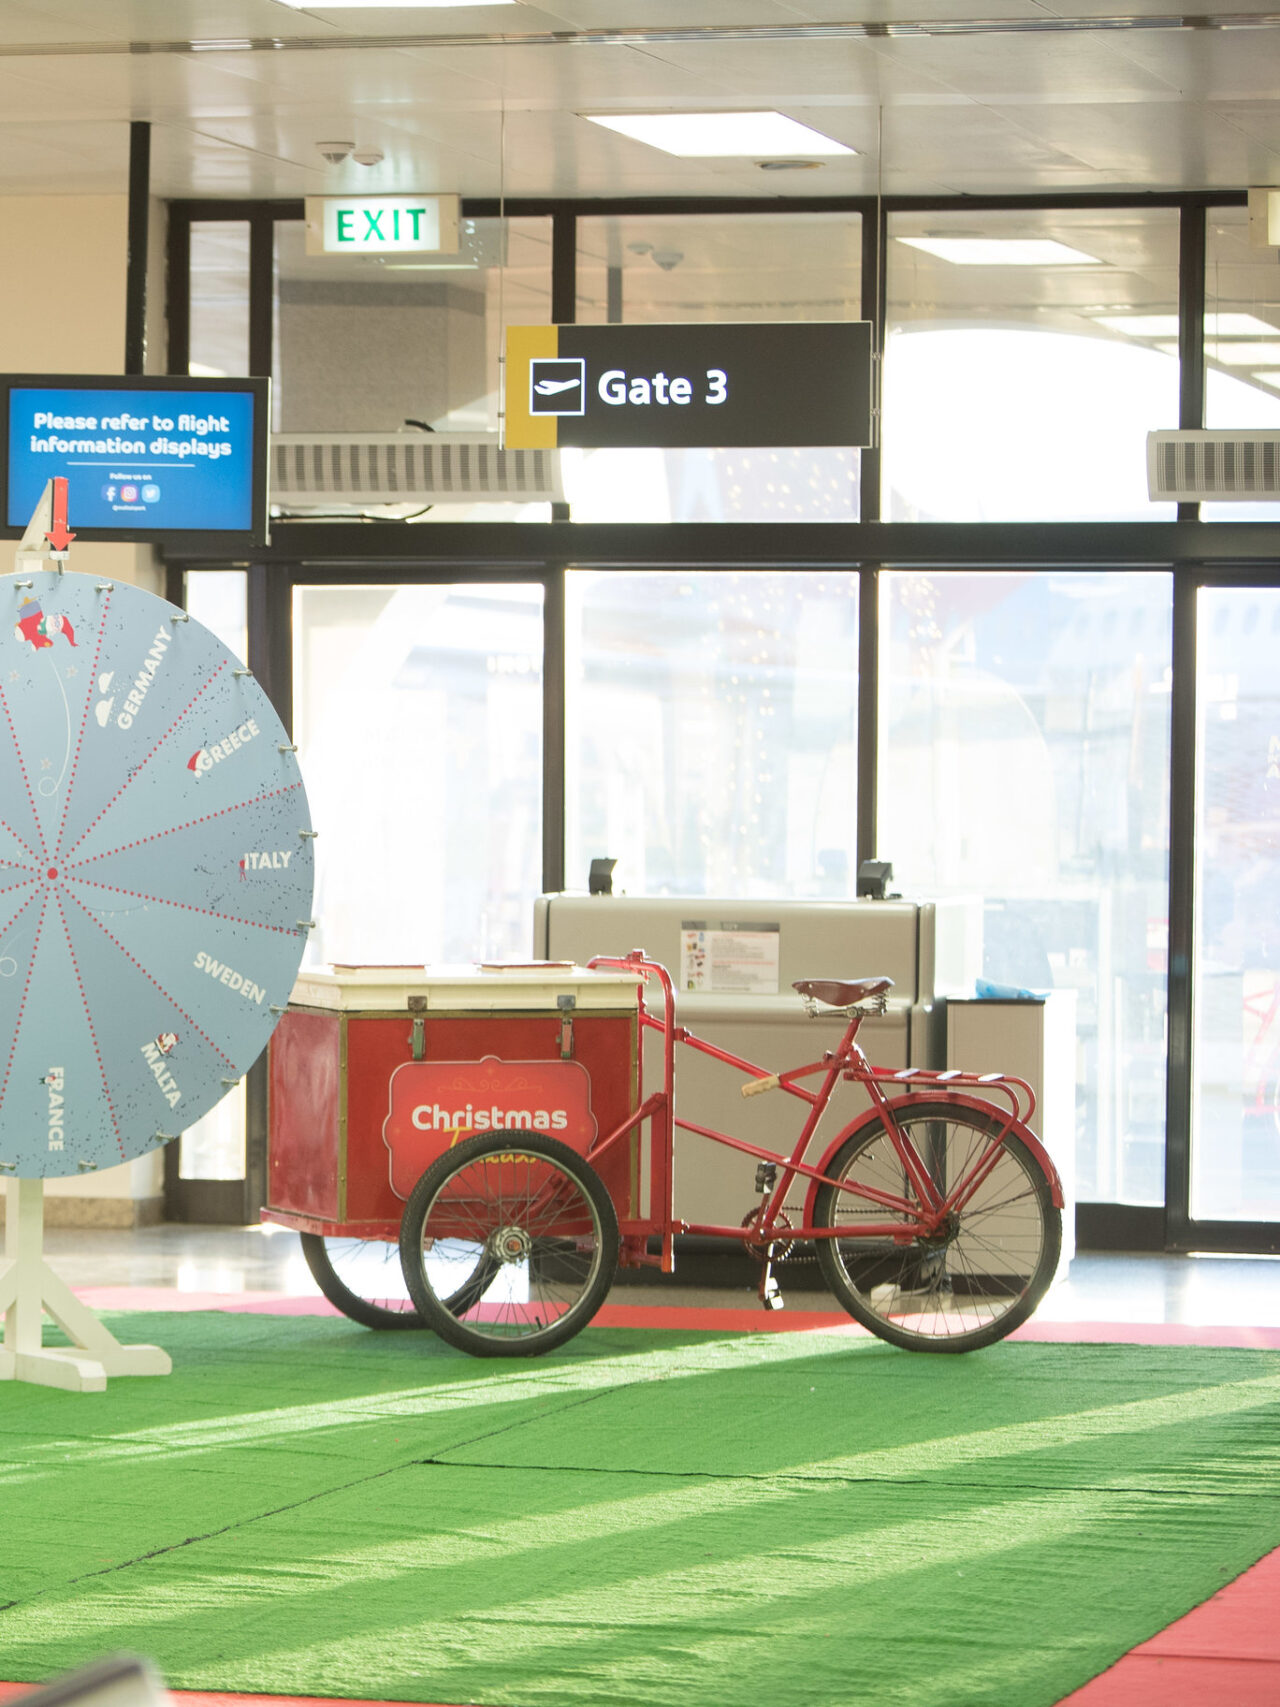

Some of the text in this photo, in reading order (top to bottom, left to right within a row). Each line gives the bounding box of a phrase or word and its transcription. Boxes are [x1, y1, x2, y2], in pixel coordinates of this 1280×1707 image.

[336, 208, 427, 242] EXIT
[597, 368, 728, 405] Gate 3
[33, 412, 230, 436] Please refer to flight
[30, 435, 232, 460] information displays
[117, 625, 173, 730] GERMANY
[198, 719, 261, 772] GREECE
[243, 851, 293, 870] ITALY
[193, 951, 268, 1005] SWEDEN
[140, 1042, 182, 1109] MALTA
[48, 1066, 65, 1152] FRANCE
[411, 1104, 568, 1130] Christmas
